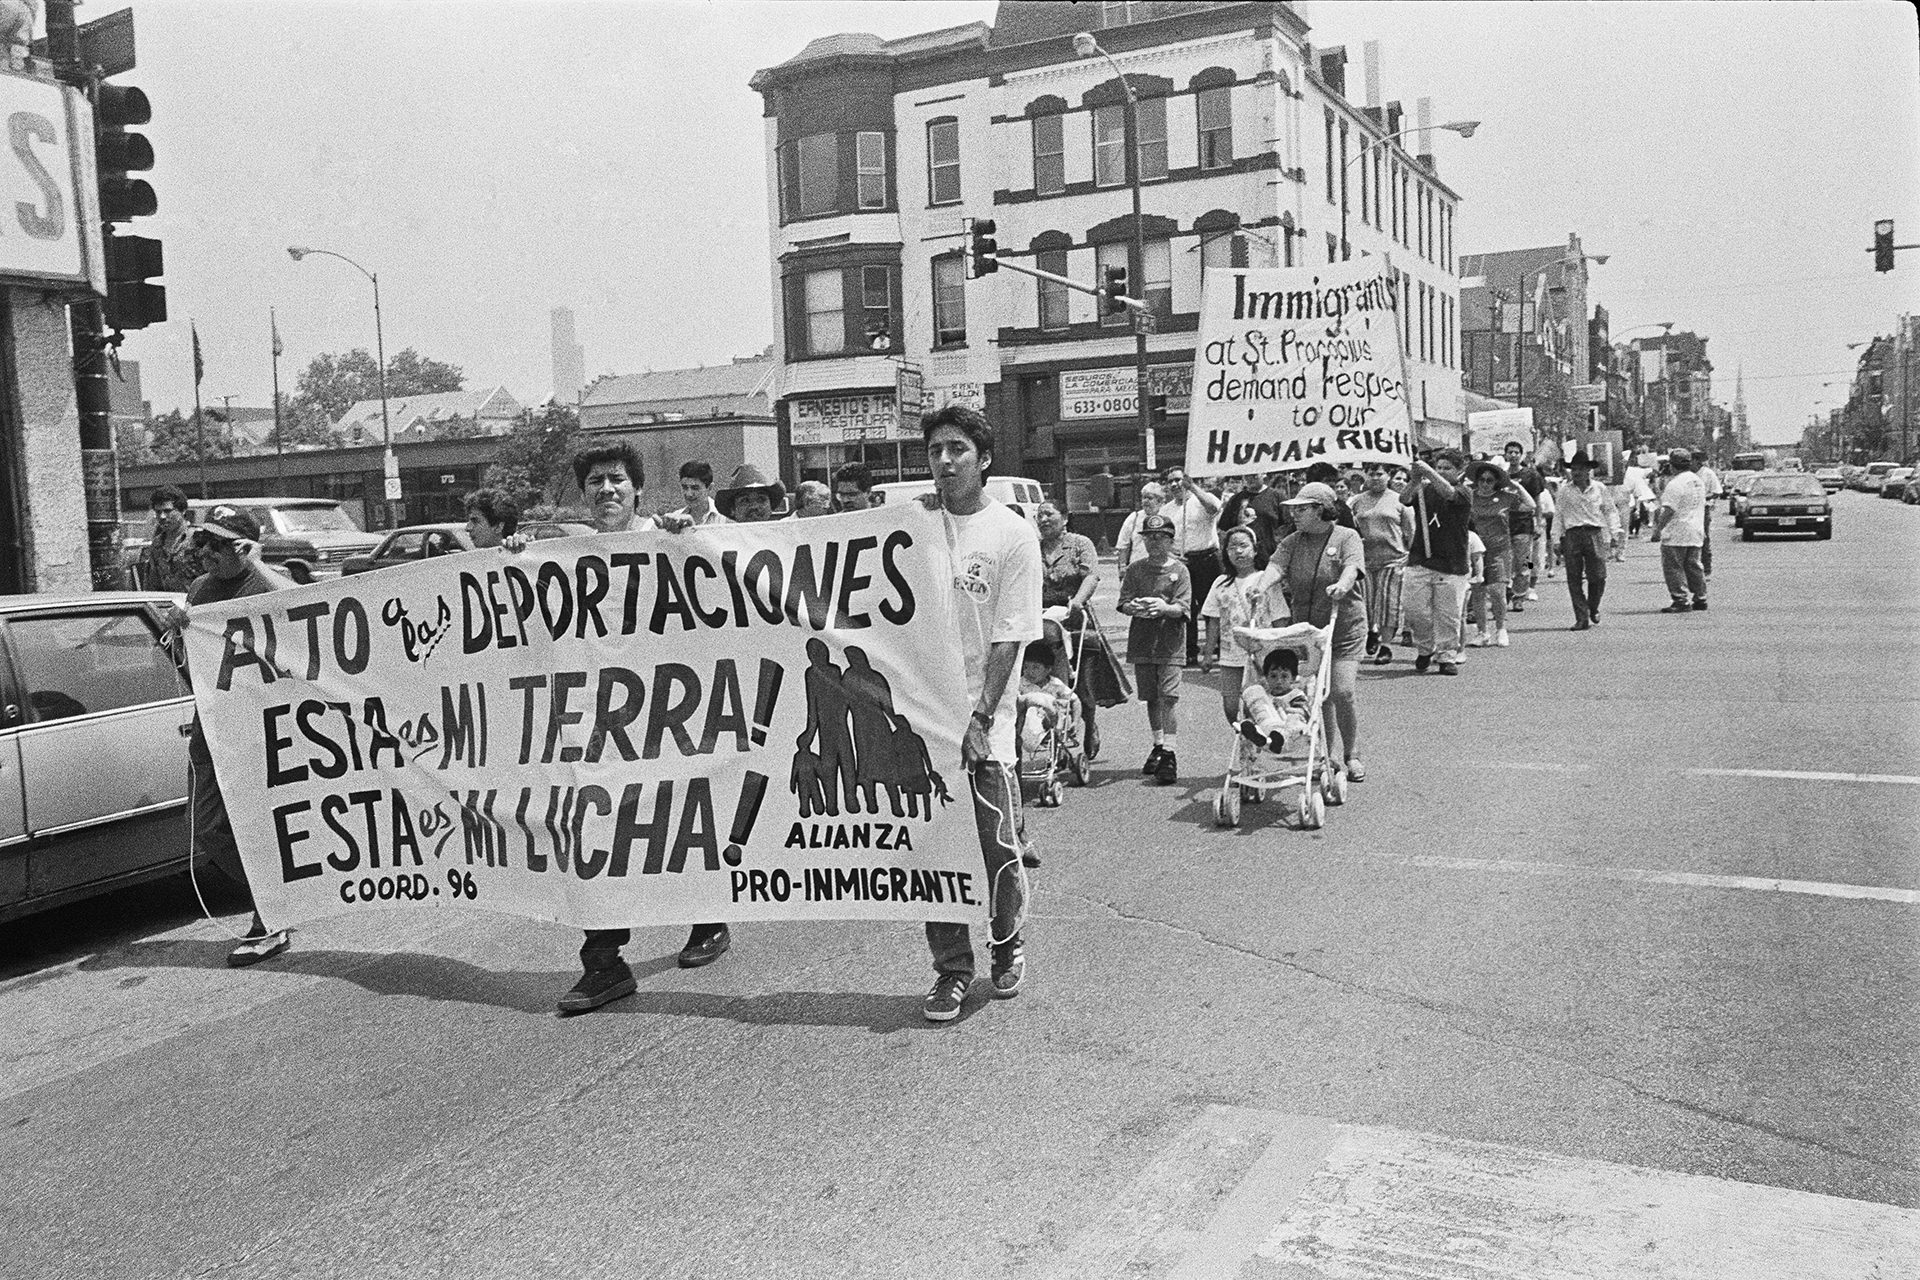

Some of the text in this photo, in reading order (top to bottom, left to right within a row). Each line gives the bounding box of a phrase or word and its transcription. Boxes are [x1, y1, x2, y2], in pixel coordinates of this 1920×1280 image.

[1205, 337, 1236, 365] at
[1207, 370, 1306, 401] demand
[799, 397, 869, 417] ERNESTO'S
[1293, 405, 1376, 427] to our
[1206, 430, 1326, 465] HUMAN
[216, 597, 371, 692] ALTO
[382, 597, 408, 627] a
[459, 530, 916, 655] DEPORTACIONES
[262, 697, 404, 789] ESTA
[438, 682, 487, 770] MI
[272, 788, 424, 883] ESTA
[450, 789, 508, 868] MI
[515, 770, 769, 880] LUCHA!
[784, 822, 913, 851] ALIANZA
[340, 868, 478, 903] COORD. 96
[731, 867, 983, 906] PRO-INMIGRANTE.
